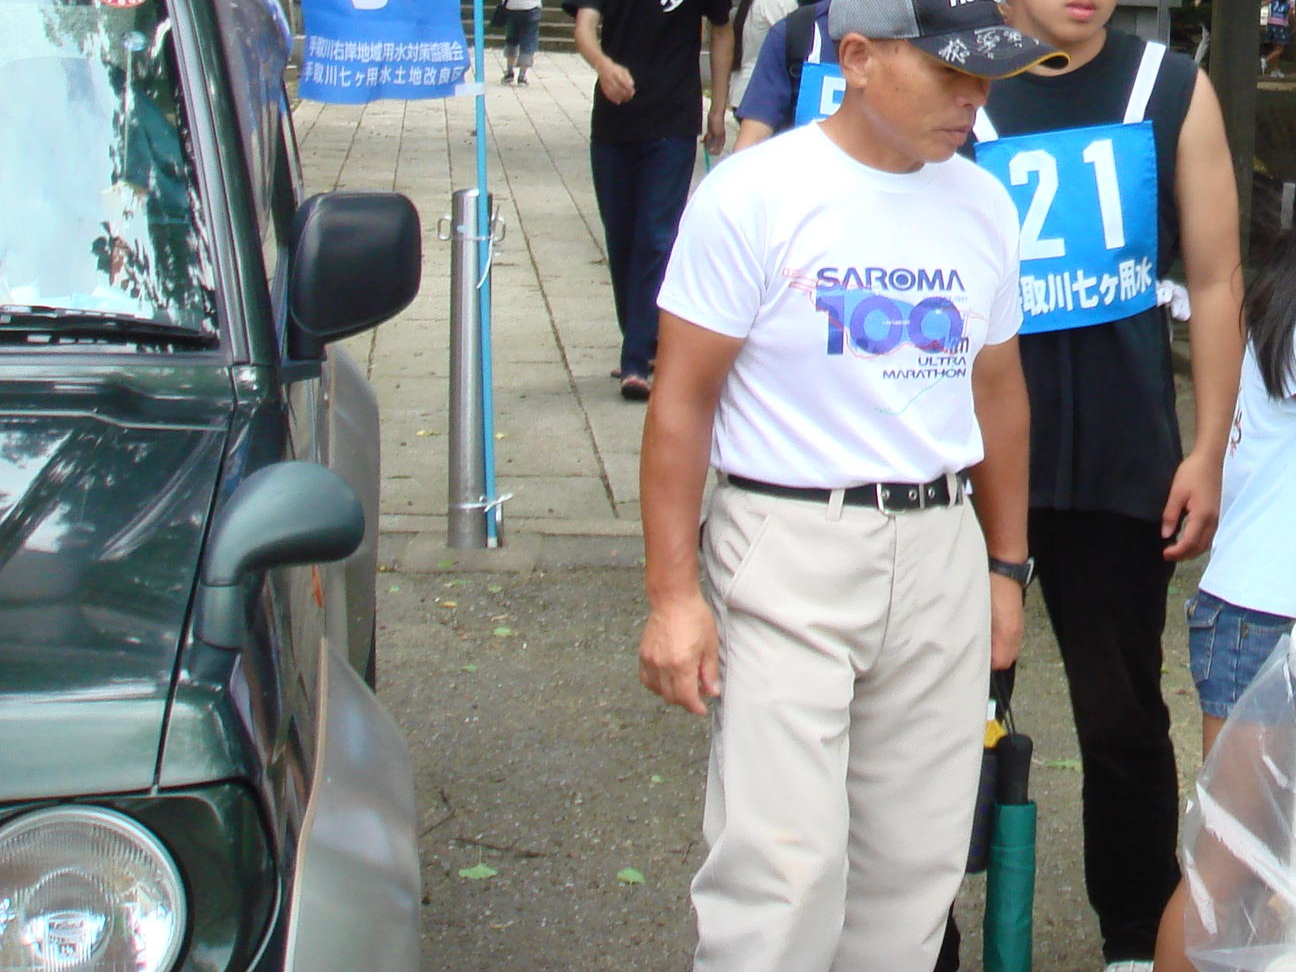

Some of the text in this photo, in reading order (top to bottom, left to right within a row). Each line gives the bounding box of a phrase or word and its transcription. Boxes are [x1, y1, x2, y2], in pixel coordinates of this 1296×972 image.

[1009, 139, 1126, 261] 21
[816, 267, 966, 292] SAROMA
[1019, 256, 1153, 317] 取川七ヶ用水
[882, 368, 967, 380] MARATHON
[918, 356, 967, 367] ULTRA
